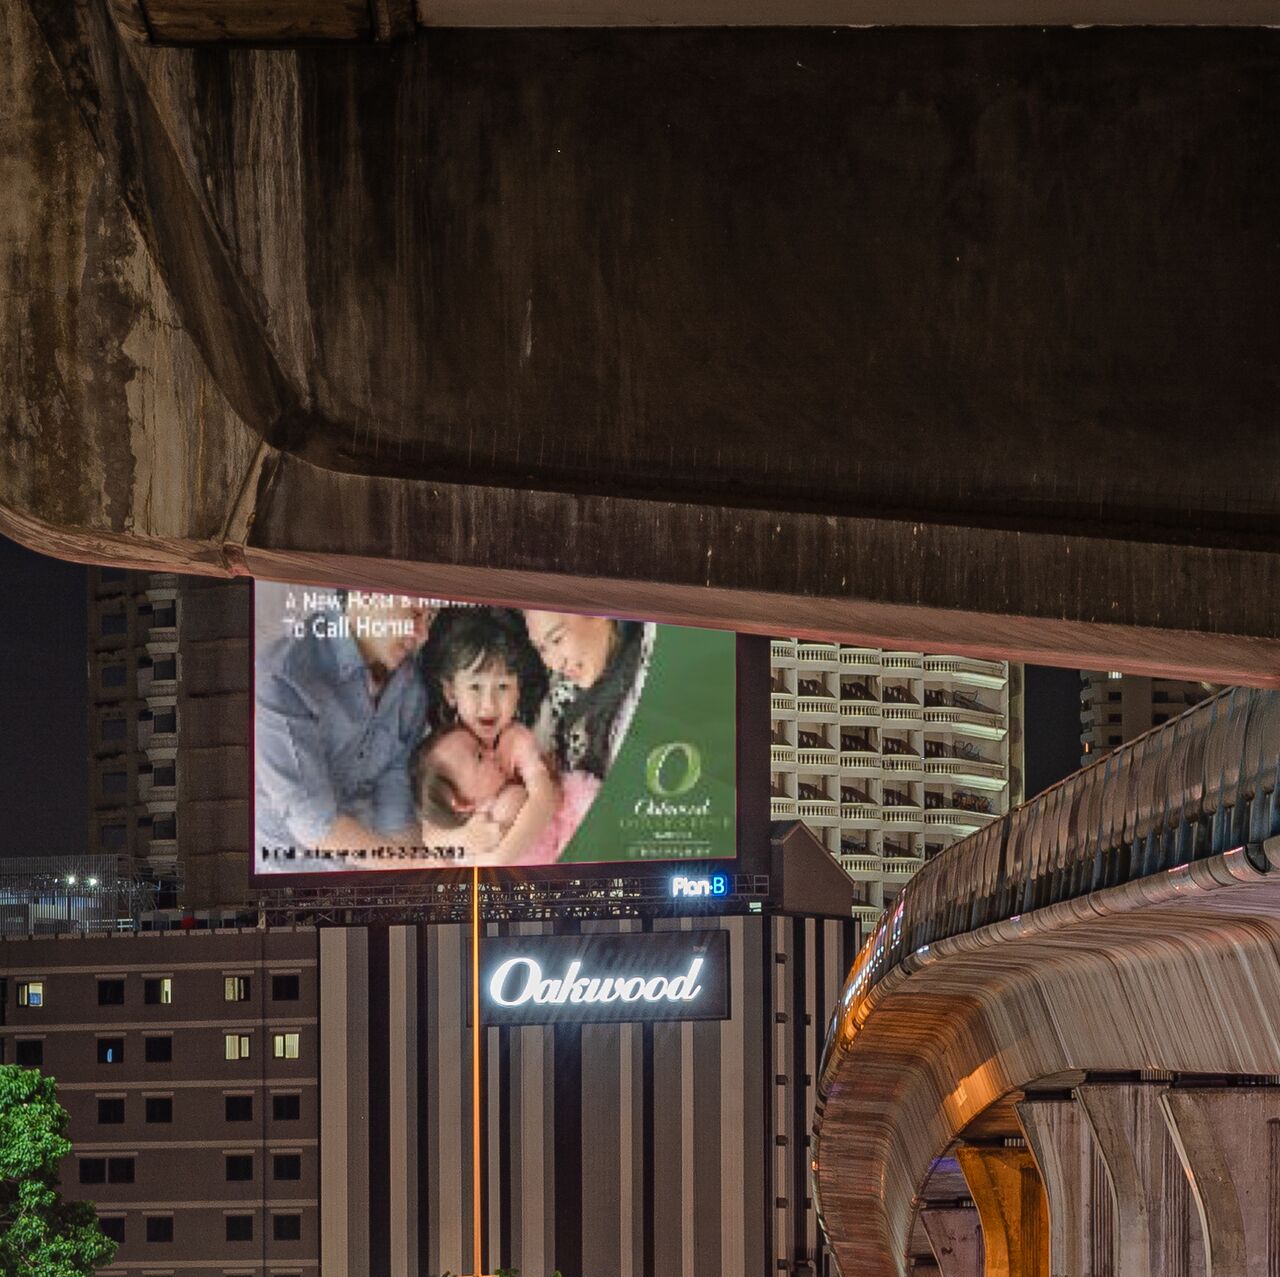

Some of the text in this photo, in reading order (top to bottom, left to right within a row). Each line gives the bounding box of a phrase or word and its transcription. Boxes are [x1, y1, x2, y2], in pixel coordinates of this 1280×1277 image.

[303, 592, 341, 610] New
[312, 616, 350, 638] Call
[357, 616, 414, 638] Home
[489, 957, 704, 1007] Oakwood
